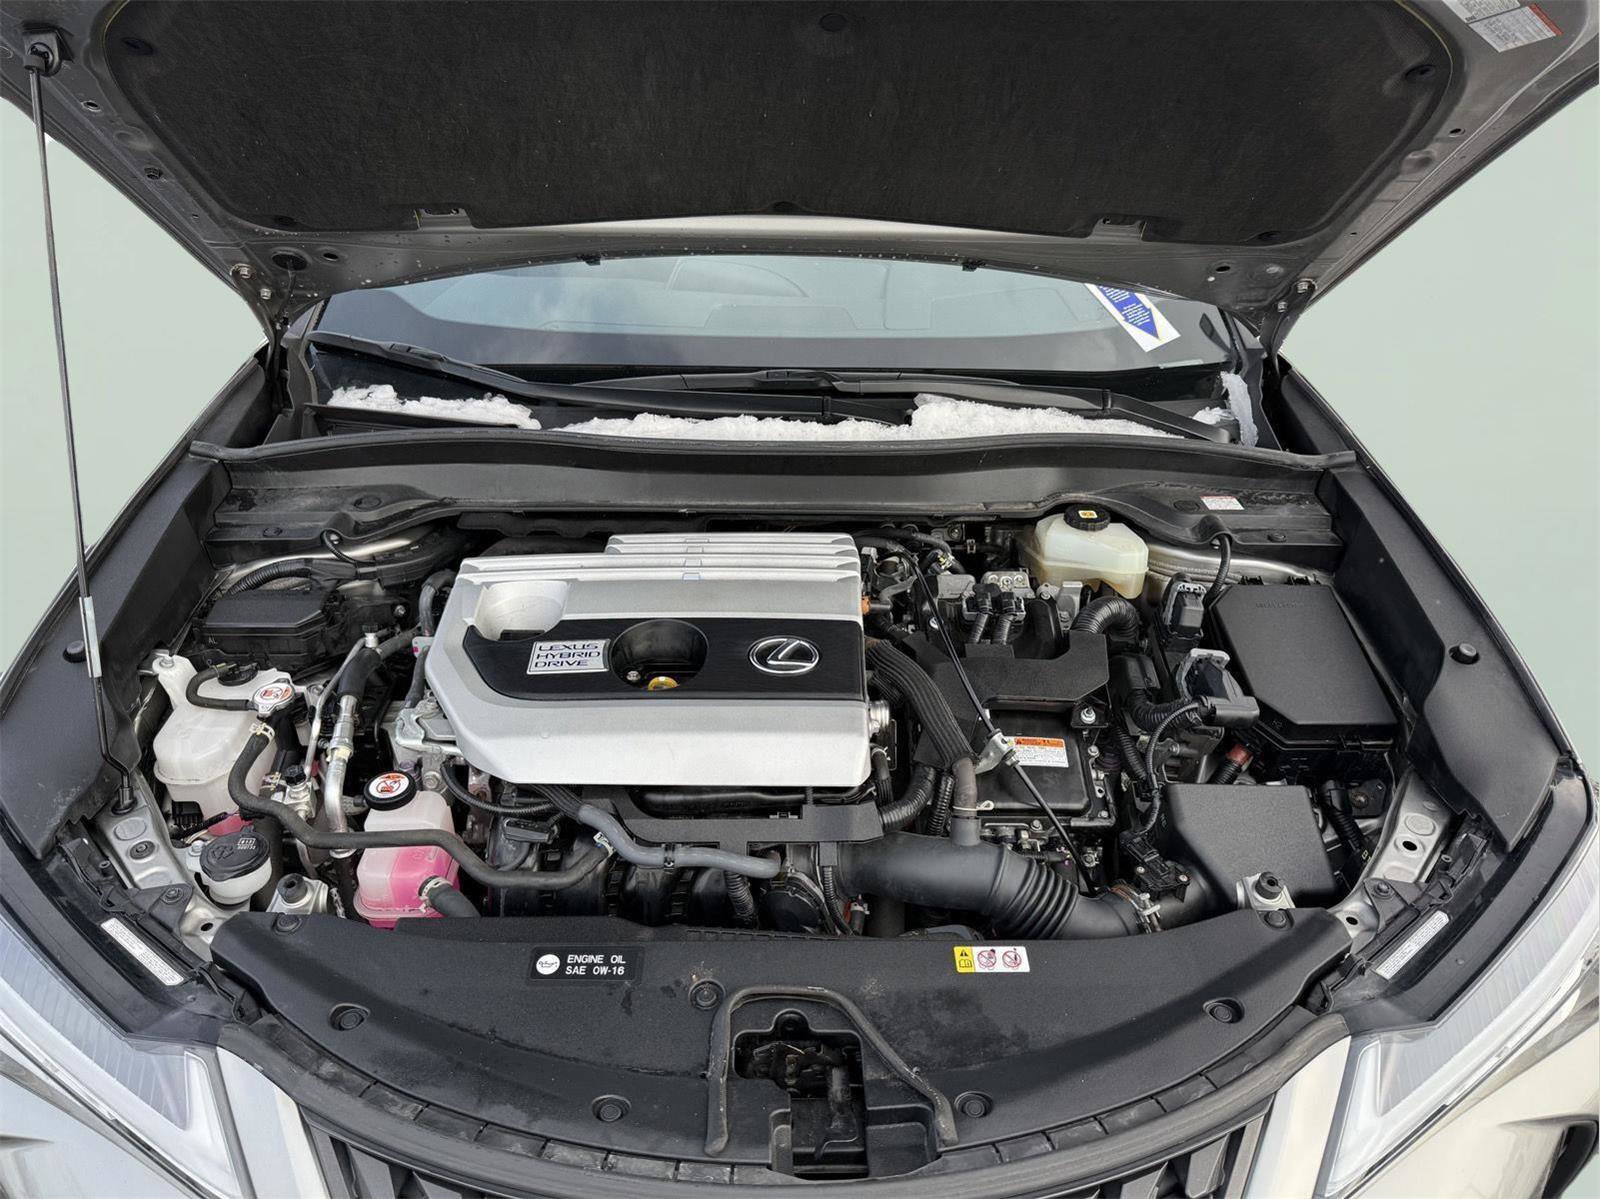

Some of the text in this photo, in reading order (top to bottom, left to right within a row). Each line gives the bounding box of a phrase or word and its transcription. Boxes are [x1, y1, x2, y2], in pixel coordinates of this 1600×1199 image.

[538, 643, 599, 652] LEXUS
[536, 651, 601, 660] HYBRID
[534, 660, 589, 668] DRIVE
[567, 954, 626, 964] ENGINE OIL
[565, 966, 625, 975] SAE 0W-16
